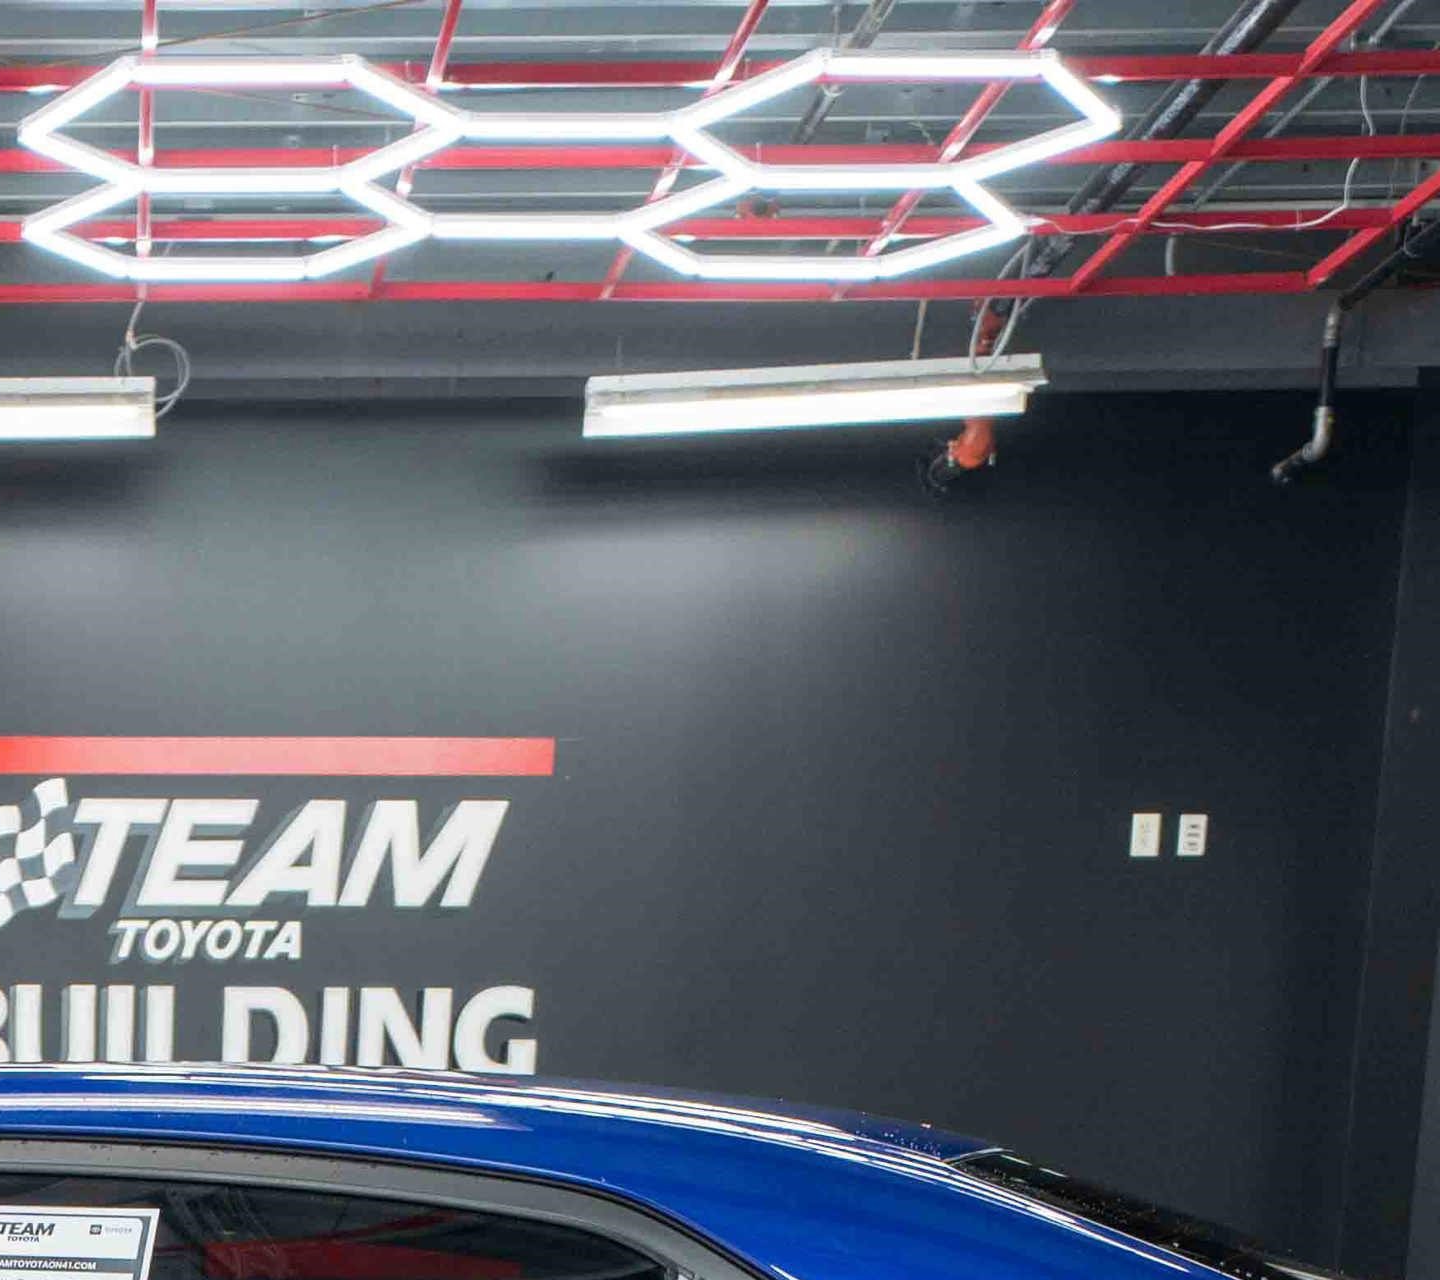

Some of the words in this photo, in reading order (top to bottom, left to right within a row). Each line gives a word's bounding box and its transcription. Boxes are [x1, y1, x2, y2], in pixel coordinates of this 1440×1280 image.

[71, 797, 510, 908] TEAM
[115, 919, 304, 961] TOYOTA
[0, 1221, 56, 1236] TEAM
[7, 1235, 40, 1243] TOYOTA
